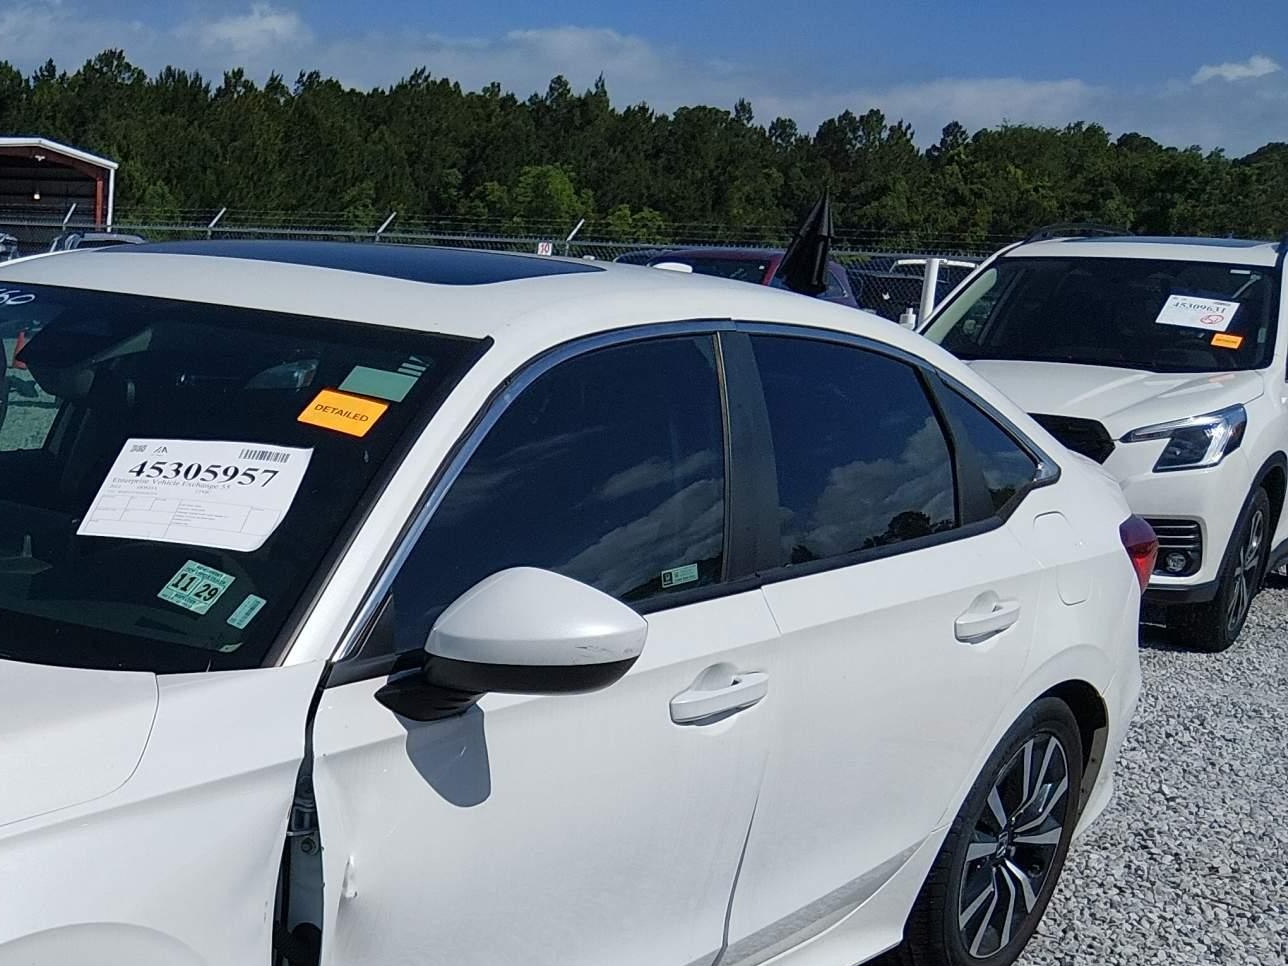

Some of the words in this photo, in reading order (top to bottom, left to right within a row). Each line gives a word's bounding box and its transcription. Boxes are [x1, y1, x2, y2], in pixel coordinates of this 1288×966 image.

[314, 403, 369, 422] DETAILED
[112, 477, 149, 485] Enterprise
[152, 479, 180, 487] Vehicle
[182, 480, 219, 490] Exchange
[128, 460, 279, 488] 45305957
[172, 573, 197, 592] 11
[194, 583, 219, 602] 29
